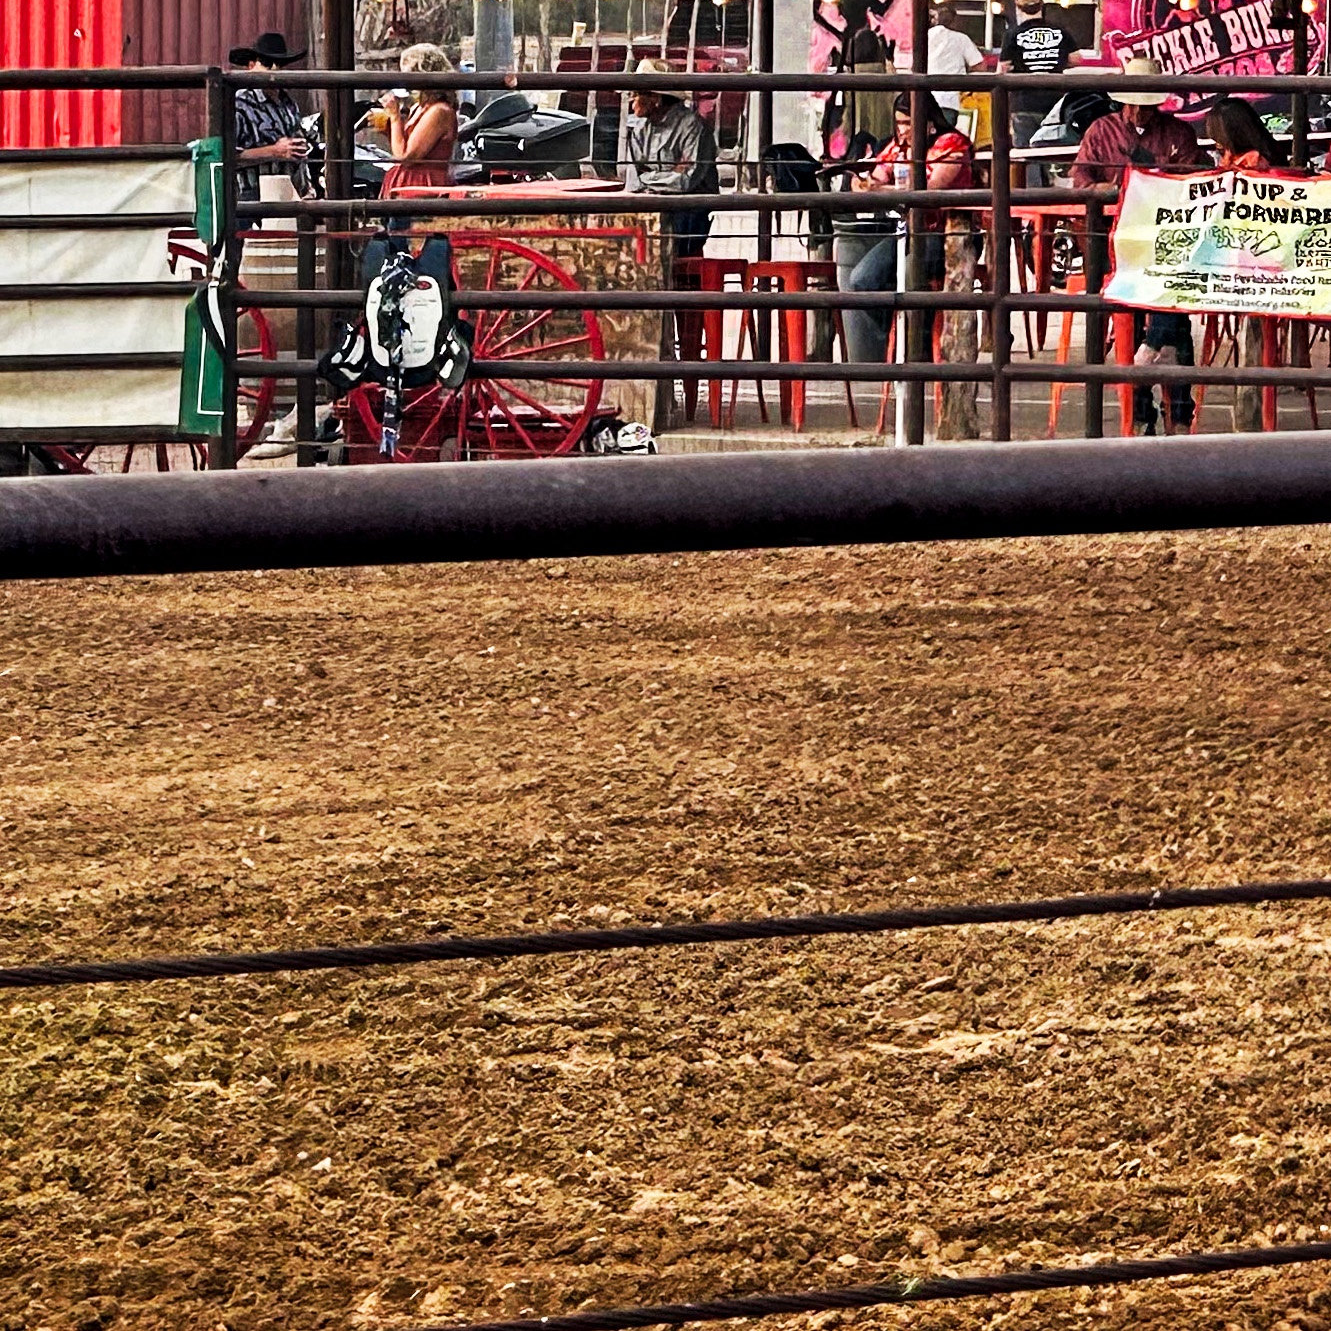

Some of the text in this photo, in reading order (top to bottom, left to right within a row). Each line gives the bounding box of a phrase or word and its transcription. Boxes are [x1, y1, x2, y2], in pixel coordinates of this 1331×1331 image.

[1253, 183, 1284, 201] UP
[1290, 188, 1308, 201] &
[1155, 206, 1198, 225] PAY
